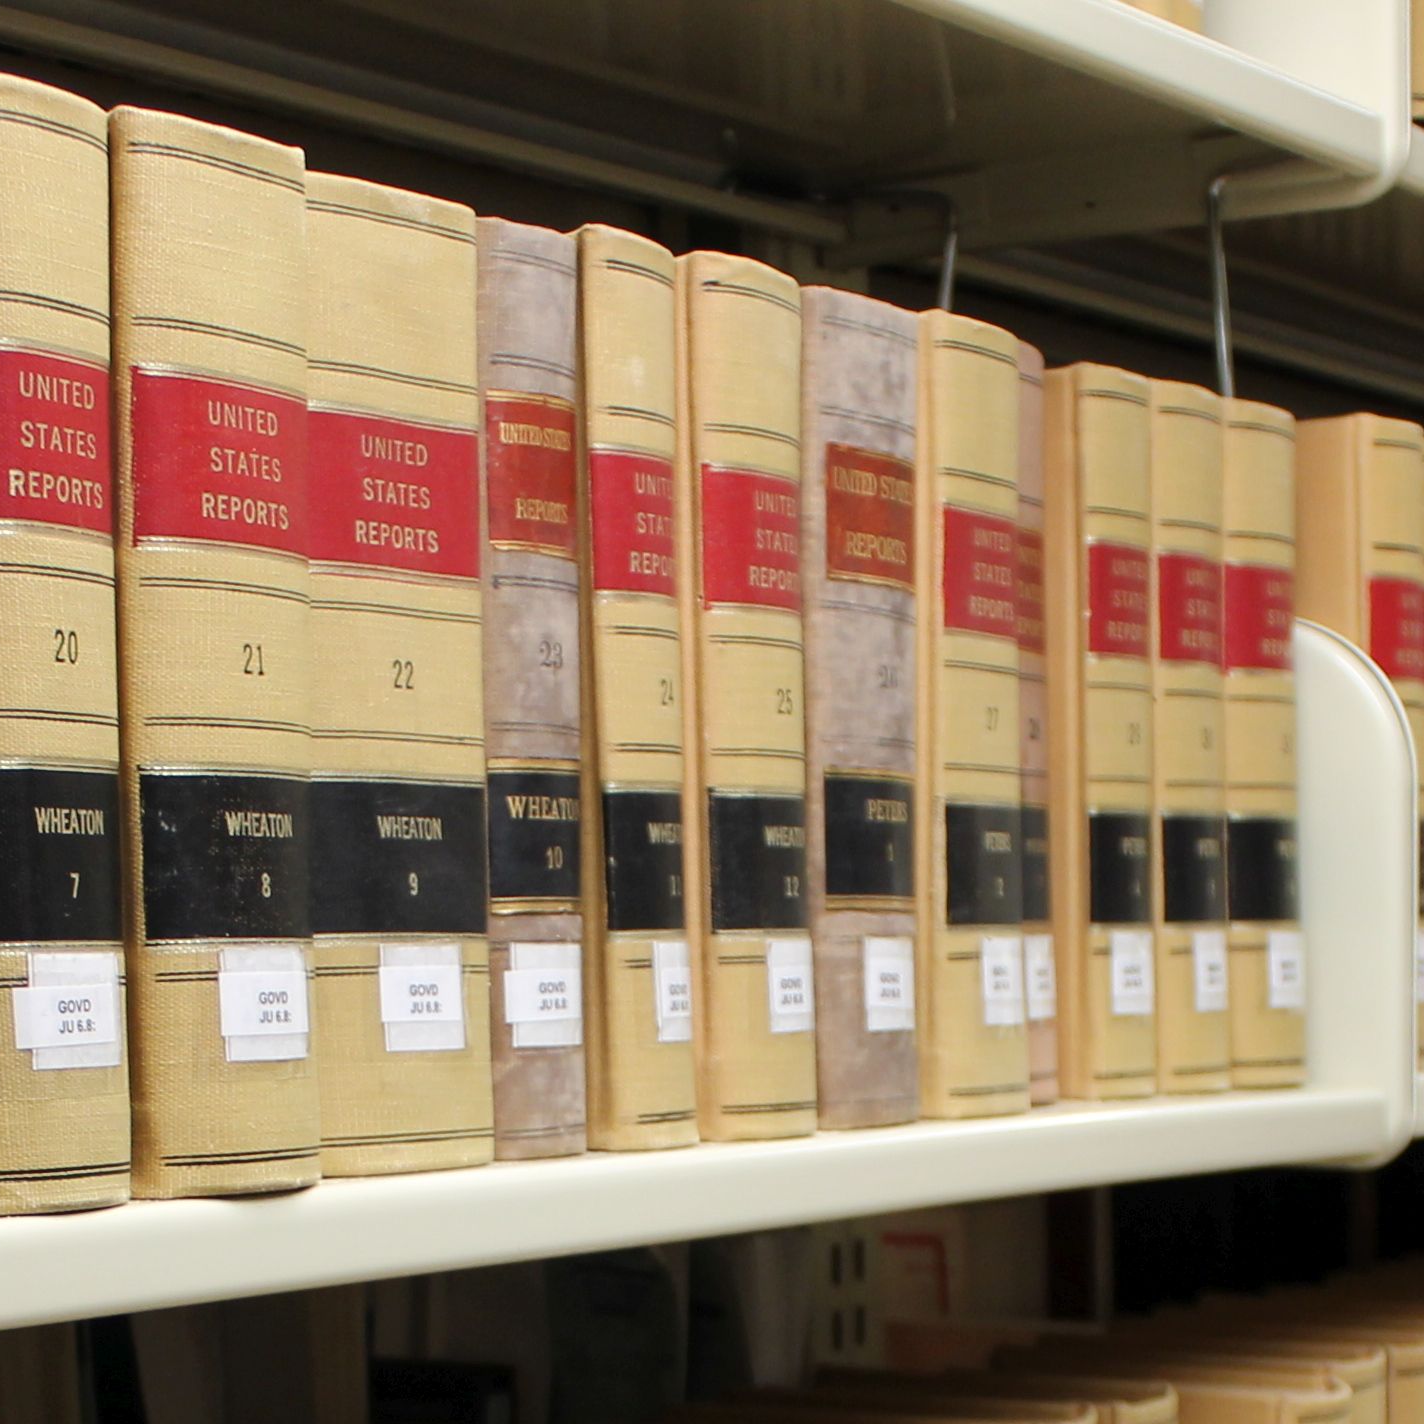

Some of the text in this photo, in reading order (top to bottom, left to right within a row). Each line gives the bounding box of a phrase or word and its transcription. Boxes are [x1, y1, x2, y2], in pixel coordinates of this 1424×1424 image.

[19, 370, 95, 409] UNITED
[208, 400, 278, 437] UNITED
[20, 420, 97, 460] STATES
[500, 421, 543, 447] UNITED
[361, 435, 428, 467] UNITED
[209, 447, 282, 483] STATES
[8, 468, 104, 510] REPORTS
[362, 478, 431, 510] STATES
[201, 492, 290, 530] REPORTS
[515, 497, 568, 524] REPORTS
[354, 520, 438, 553] REPORTS
[846, 530, 907, 564] REPORTS
[53, 629, 78, 664] 20
[243, 643, 265, 676] 21
[540, 641, 563, 667] 23
[392, 659, 414, 690] 22
[35, 807, 104, 837] WHEATON
[506, 796, 577, 821] WHEATO
[226, 811, 292, 839] WHEATON
[377, 814, 442, 841] WHEATON
[547, 847, 564, 869] 10
[70, 872, 81, 898] 7
[261, 872, 271, 898] 8
[409, 872, 419, 896] 9
[258, 990, 289, 1006] GOVD
[409, 983, 439, 998] GOVD
[57, 998, 91, 1015] GOVD
[259, 1010, 274, 1025] JU
[410, 1000, 425, 1015] JU
[58, 1018, 97, 1035] JU 6.8:
